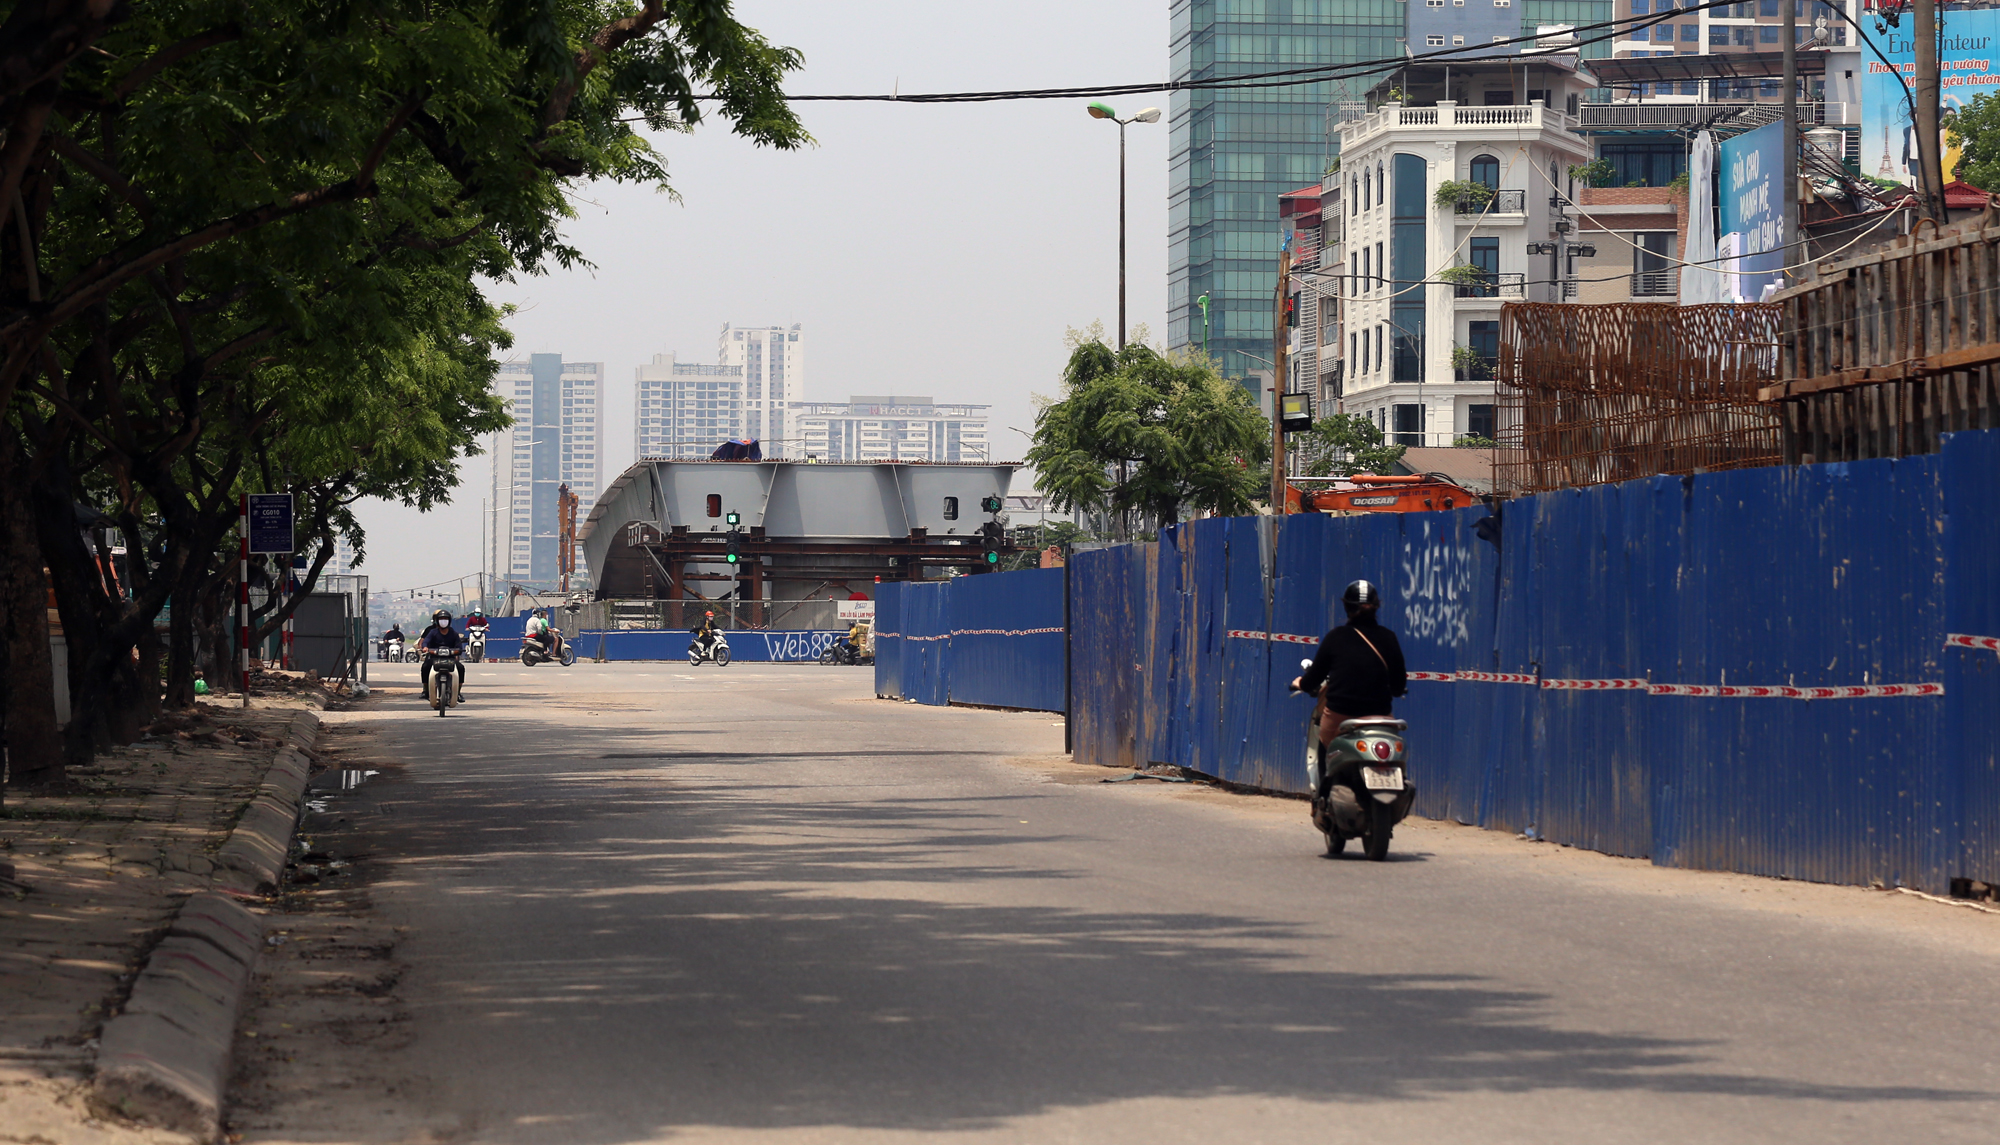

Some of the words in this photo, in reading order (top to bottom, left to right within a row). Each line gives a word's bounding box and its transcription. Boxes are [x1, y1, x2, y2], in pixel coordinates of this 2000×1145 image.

[1888, 33, 1991, 54] Ennteur
[1942, 75, 1964, 89] yêu
[1353, 497, 1395, 505] DOOSAN
